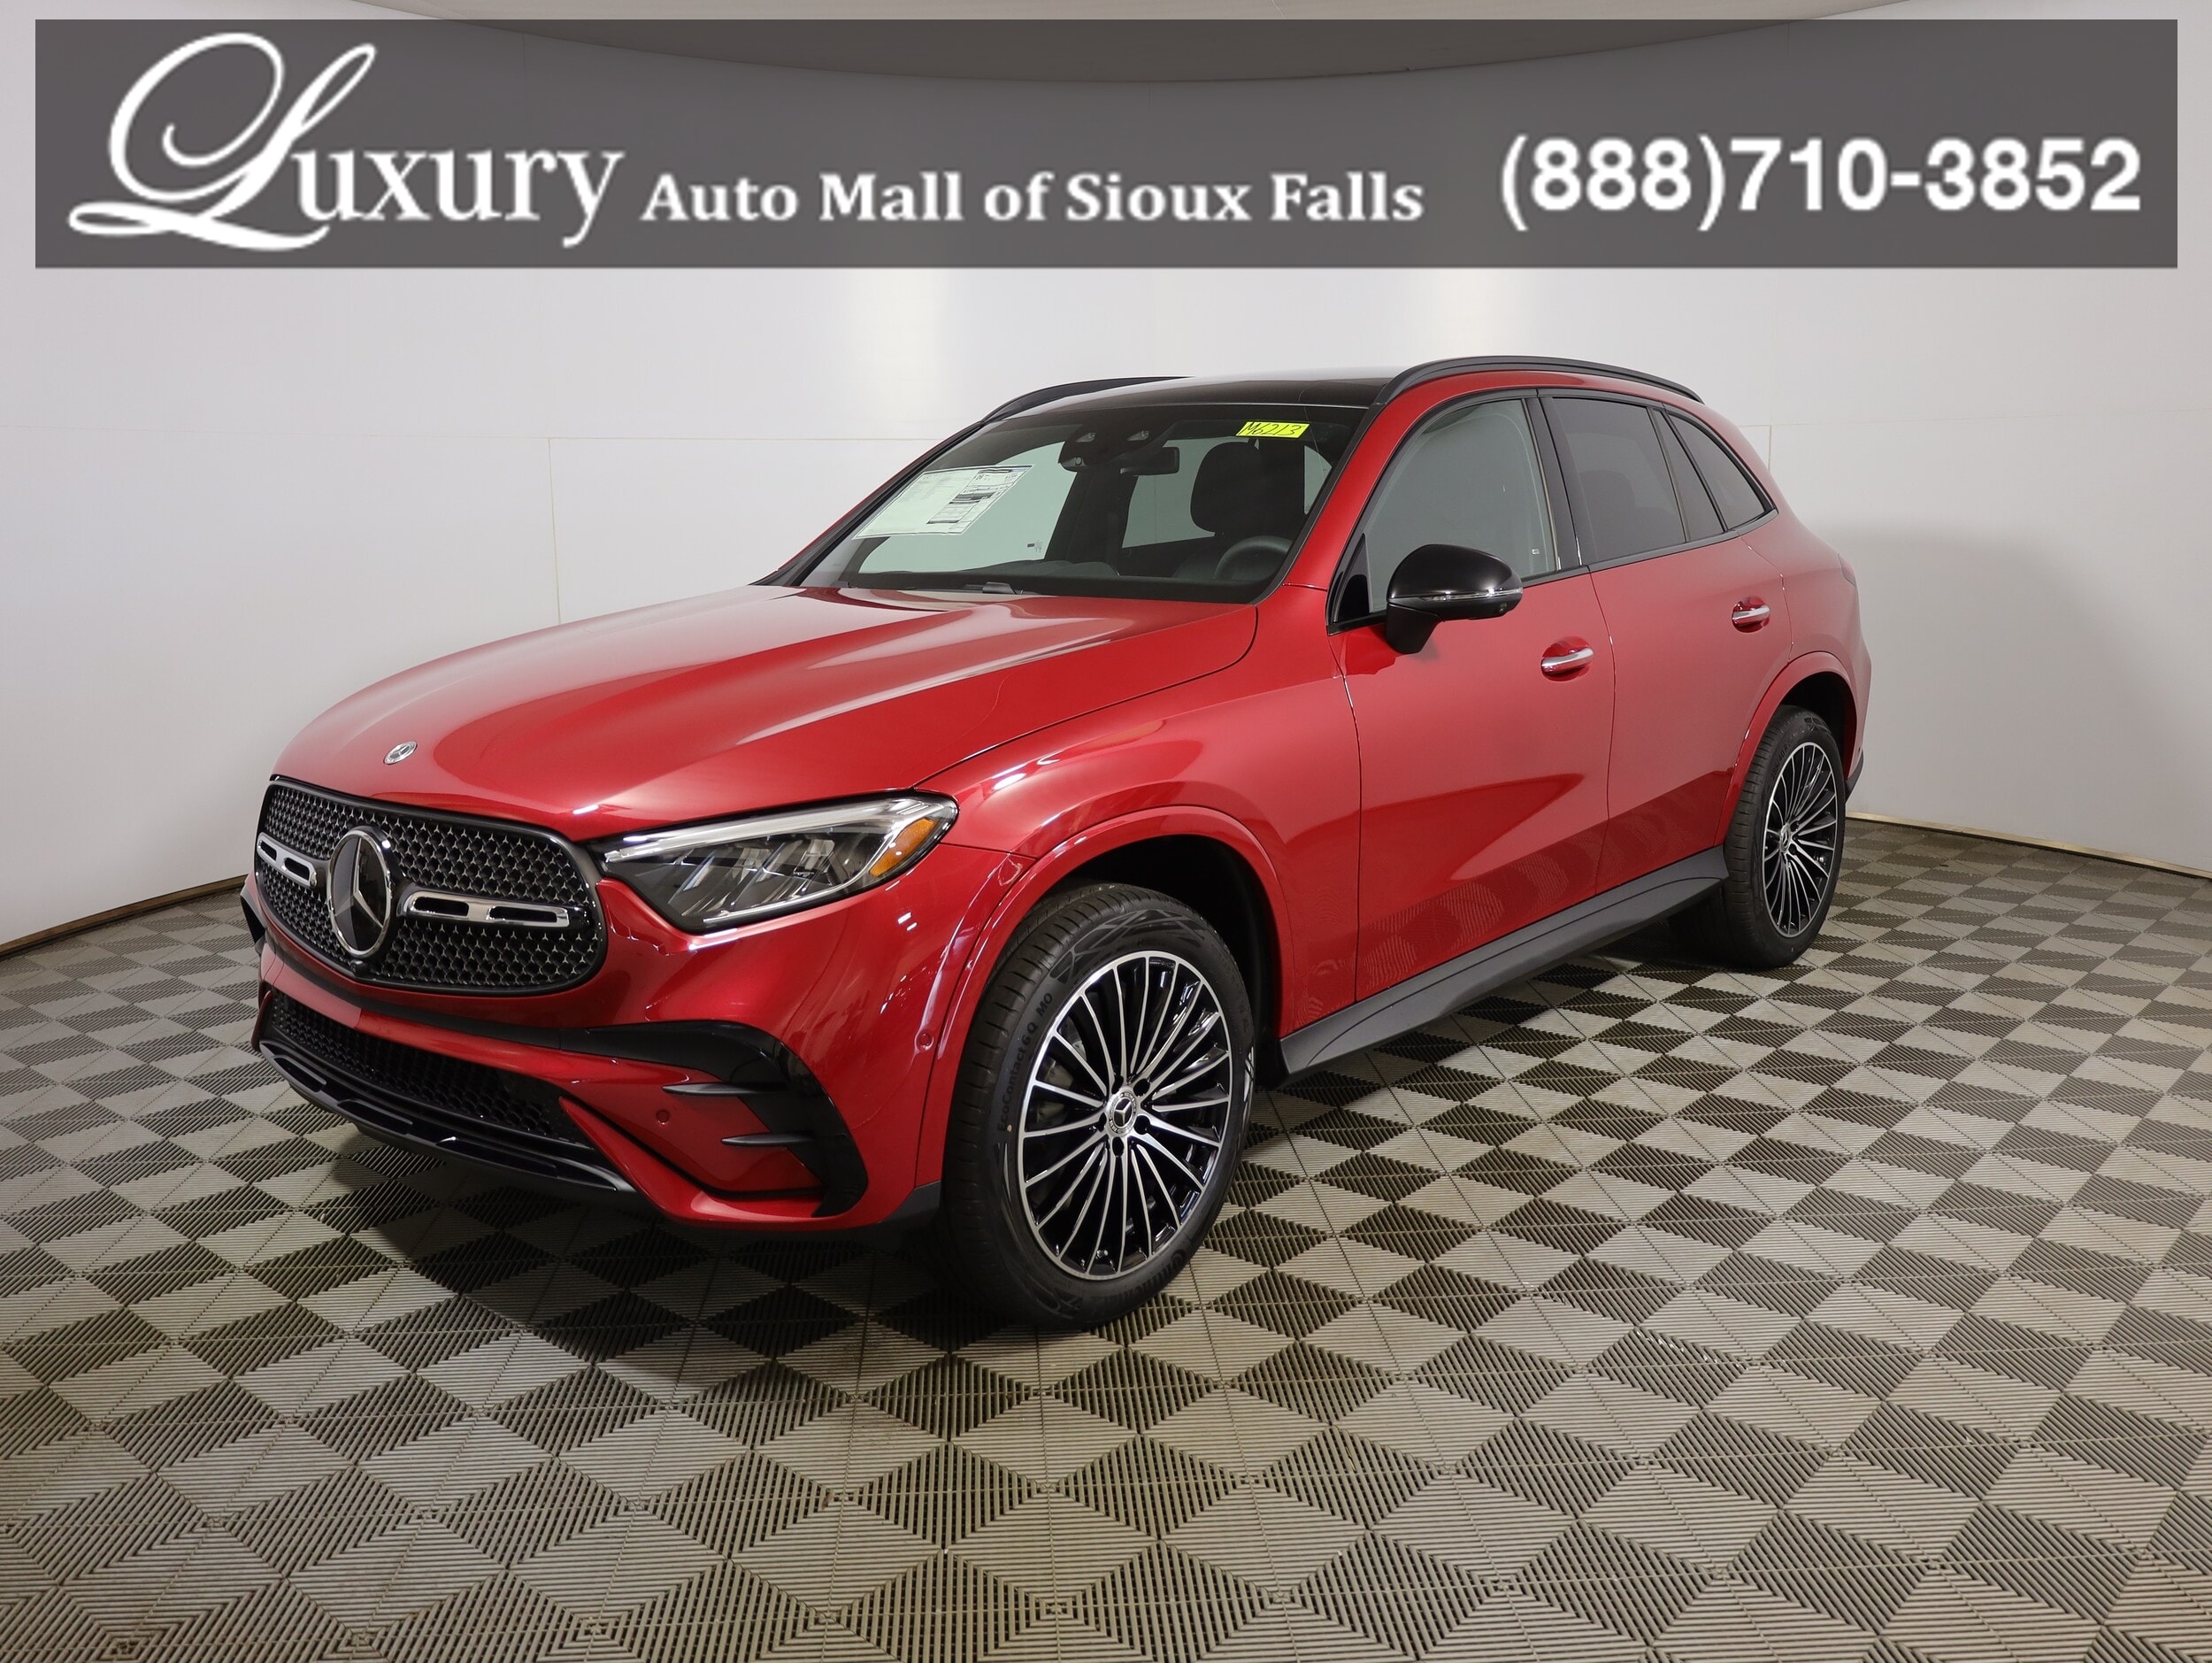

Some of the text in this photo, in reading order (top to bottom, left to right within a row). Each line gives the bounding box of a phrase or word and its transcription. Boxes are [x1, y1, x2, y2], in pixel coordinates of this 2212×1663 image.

[996, 1047, 1027, 1132] EcoContact
[1021, 1034, 1031, 1047] 6
[1035, 992, 1054, 1018] MO
